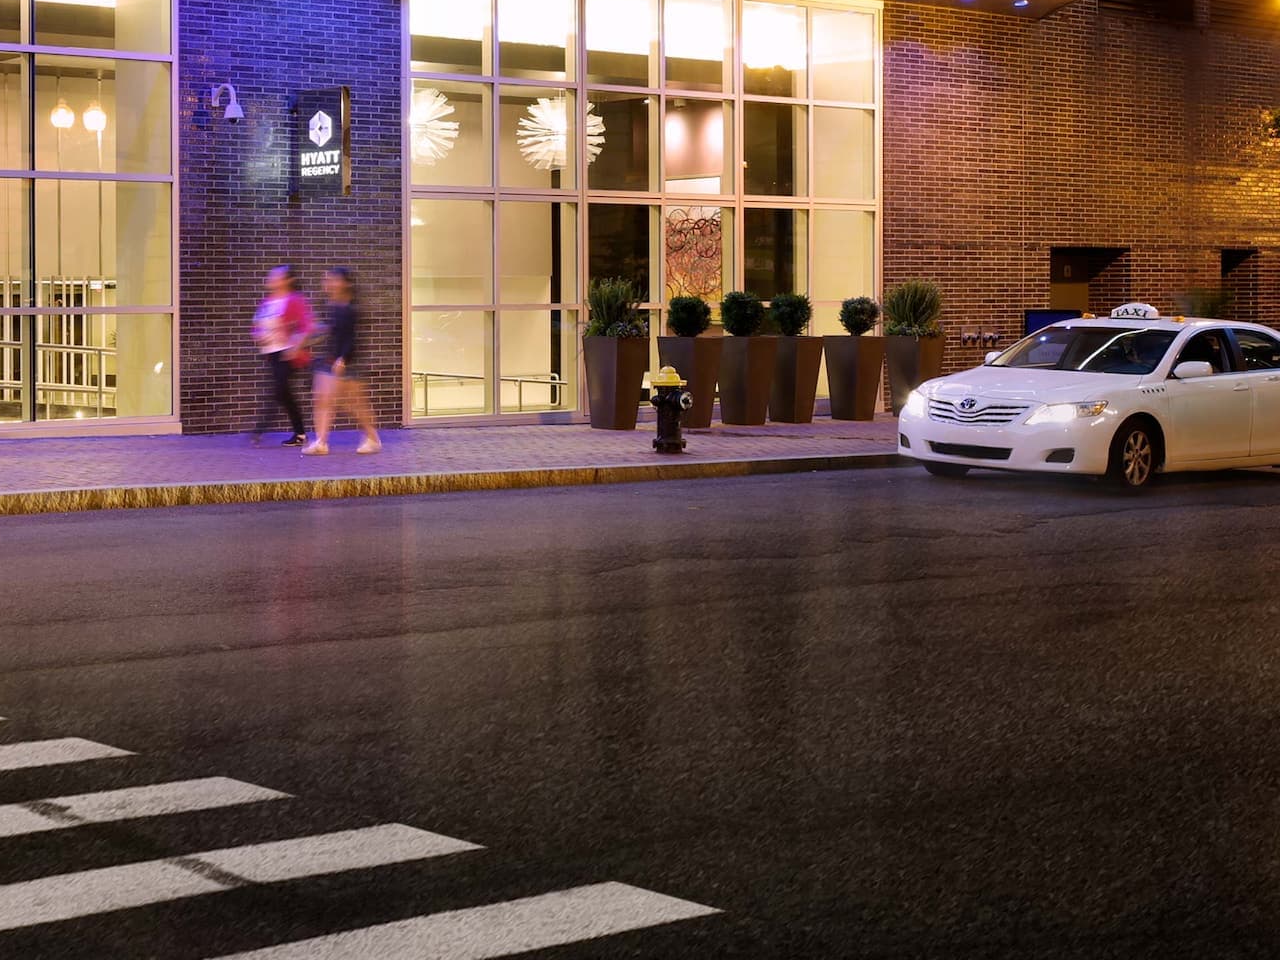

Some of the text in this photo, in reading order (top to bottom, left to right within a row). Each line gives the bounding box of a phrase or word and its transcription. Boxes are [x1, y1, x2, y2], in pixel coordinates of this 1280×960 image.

[301, 150, 340, 166] HYATT
[301, 164, 340, 177] REGENCY
[1115, 307, 1150, 319] TAXI
